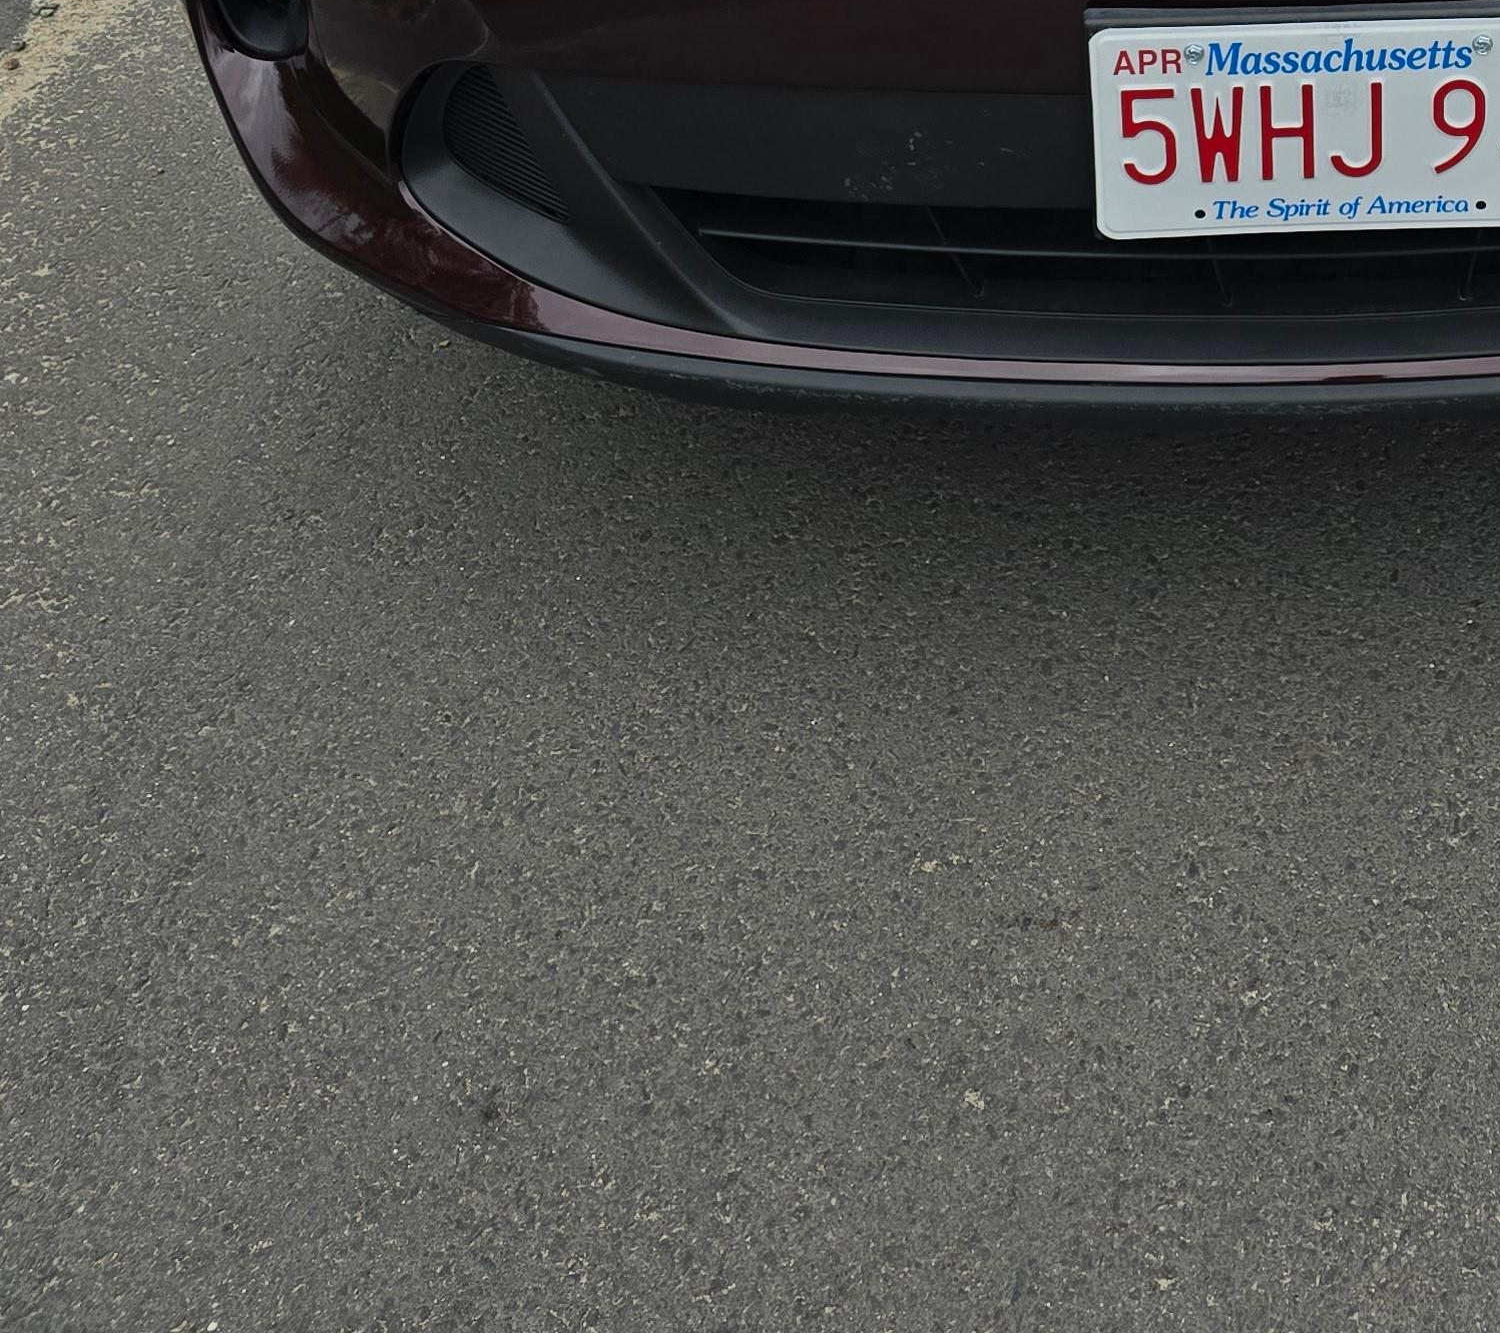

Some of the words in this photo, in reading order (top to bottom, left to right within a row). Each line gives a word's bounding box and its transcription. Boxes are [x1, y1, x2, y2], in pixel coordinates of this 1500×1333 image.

[1113, 48, 1182, 76] APR
[1205, 38, 1473, 76] Massachusetts
[1120, 82, 1383, 185] 5WHJ
[1213, 200, 1259, 220] The
[1266, 197, 1331, 222] Spirit
[1338, 196, 1362, 219] of
[1366, 195, 1470, 216] America
